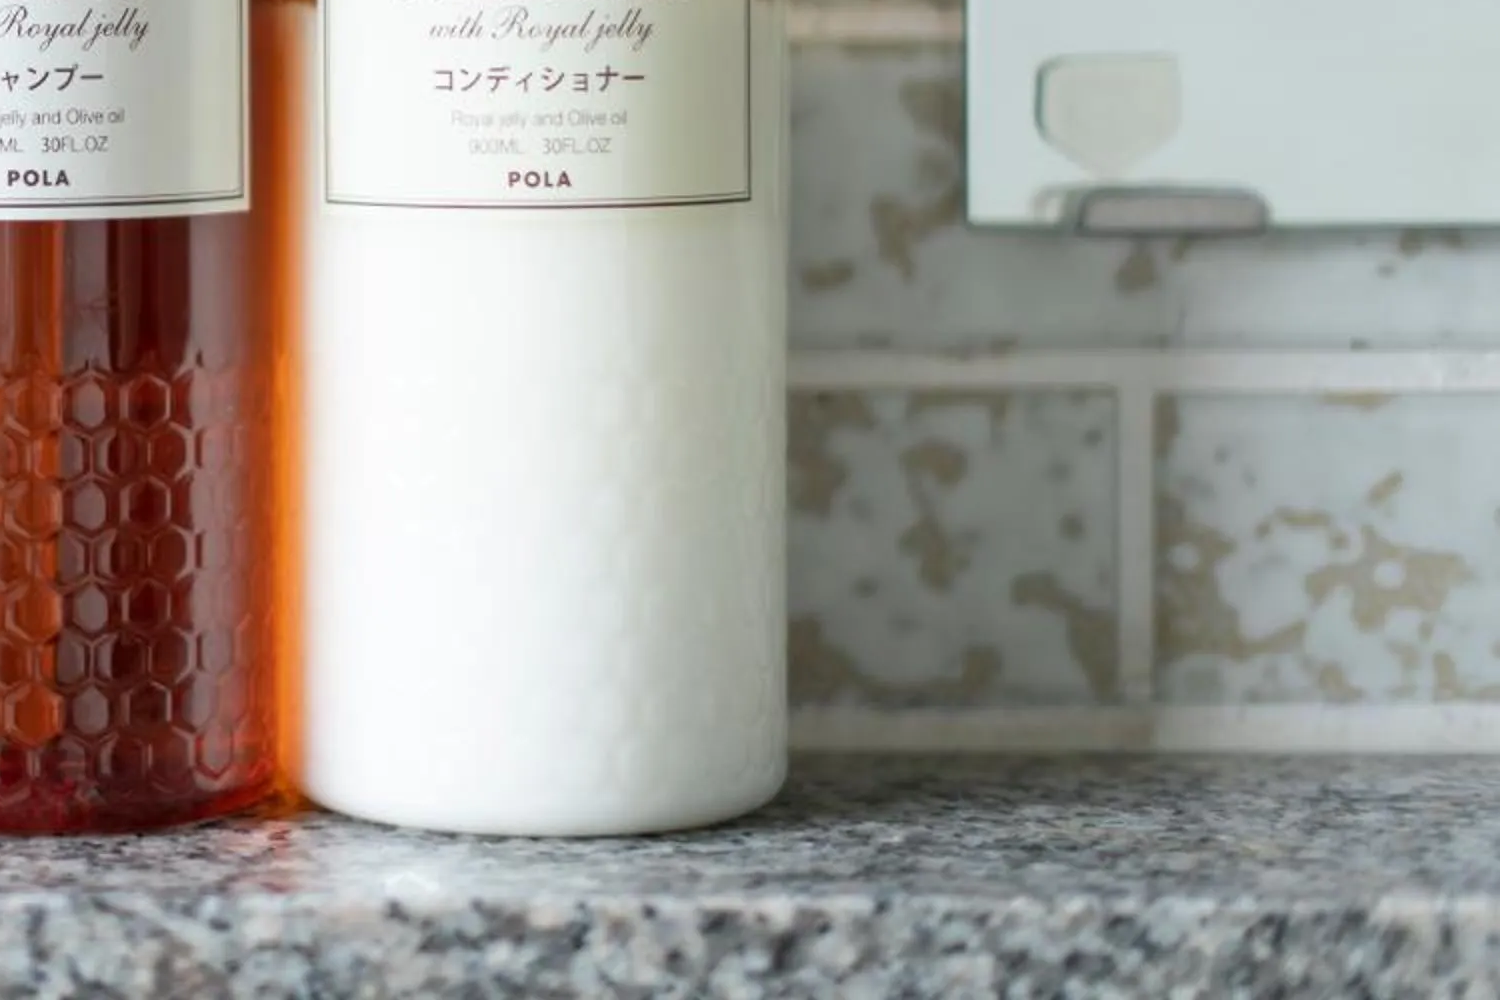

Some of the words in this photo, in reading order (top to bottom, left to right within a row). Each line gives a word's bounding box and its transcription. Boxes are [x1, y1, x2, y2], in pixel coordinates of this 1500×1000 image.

[82, 7, 150, 51] jelly
[429, 10, 485, 40] with
[490, 5, 593, 52] Royal
[583, 8, 657, 52] jelly
[433, 65, 646, 93] コンディショナー
[31, 110, 61, 124] and
[65, 109, 104, 124] Olive
[108, 109, 125, 124] oil
[451, 111, 494, 129] Royal
[498, 111, 527, 130] jelly
[531, 111, 562, 127] and
[567, 110, 606, 127] Olive
[610, 110, 628, 126] oil
[7, 169, 69, 187] POLA
[508, 170, 572, 188] POLA
